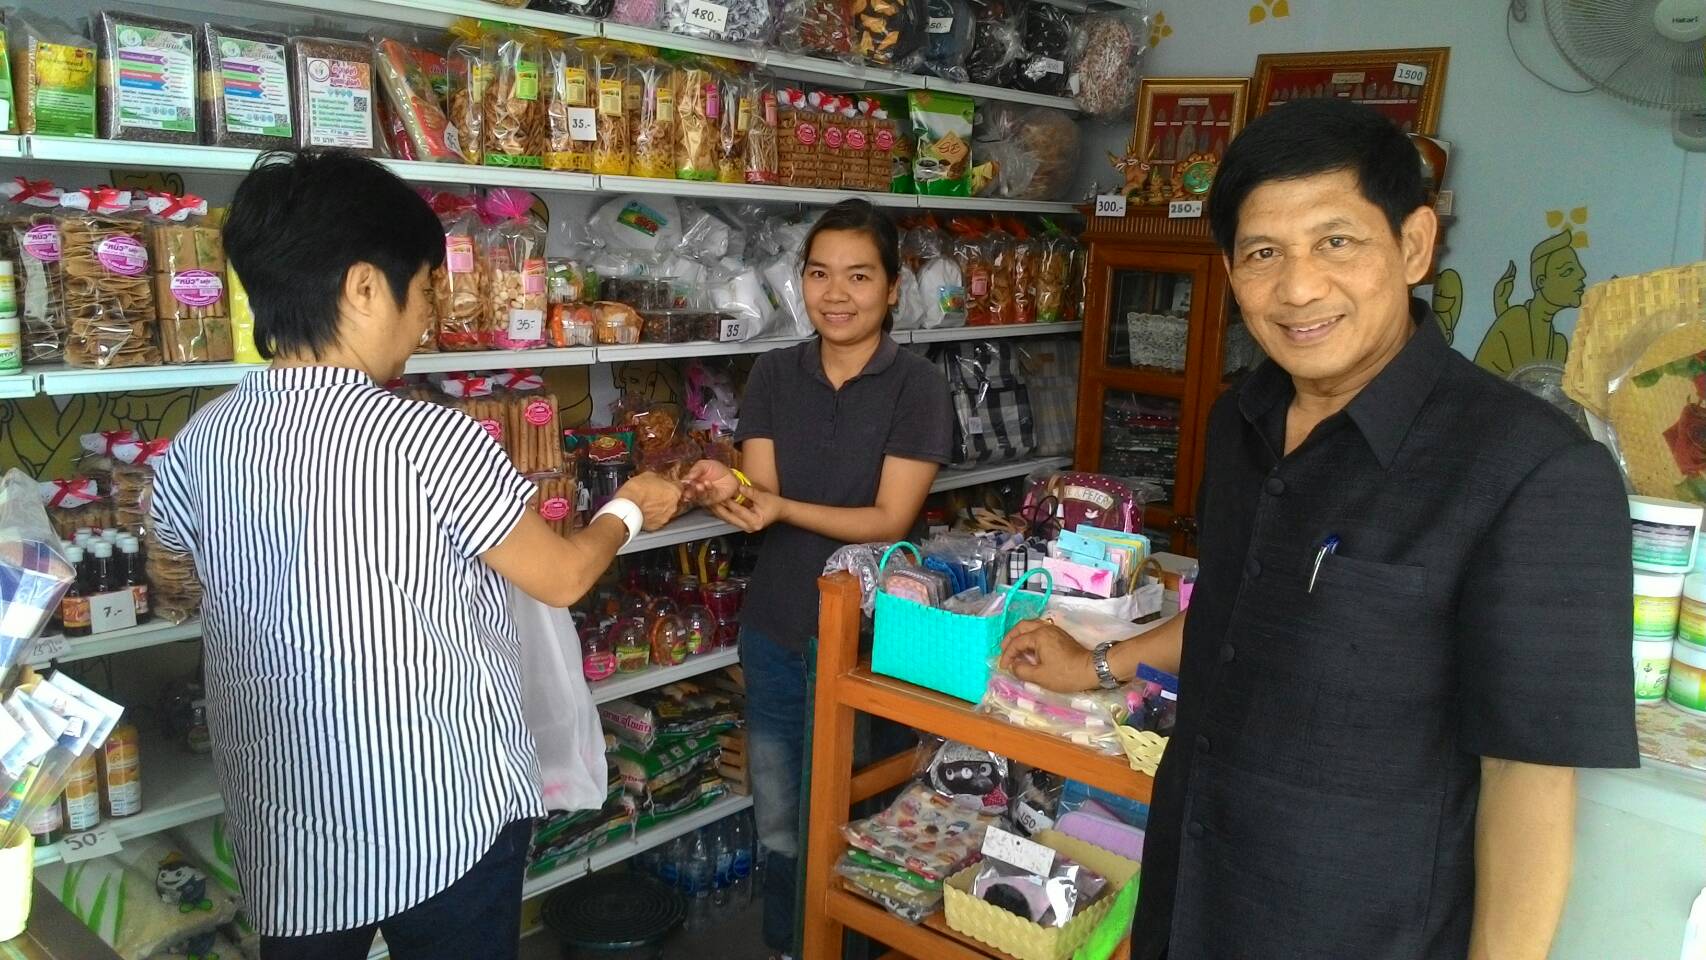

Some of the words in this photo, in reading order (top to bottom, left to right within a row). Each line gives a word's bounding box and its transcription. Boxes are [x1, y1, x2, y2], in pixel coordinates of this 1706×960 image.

[691, 8, 722, 24] 480.-
[1397, 68, 1423, 81] 1500
[572, 118, 591, 129] 35.-
[1170, 203, 1201, 213] 250.-
[726, 323, 739, 338] 35
[104, 607, 122, 617] 7.-
[1020, 811, 1037, 829] 150
